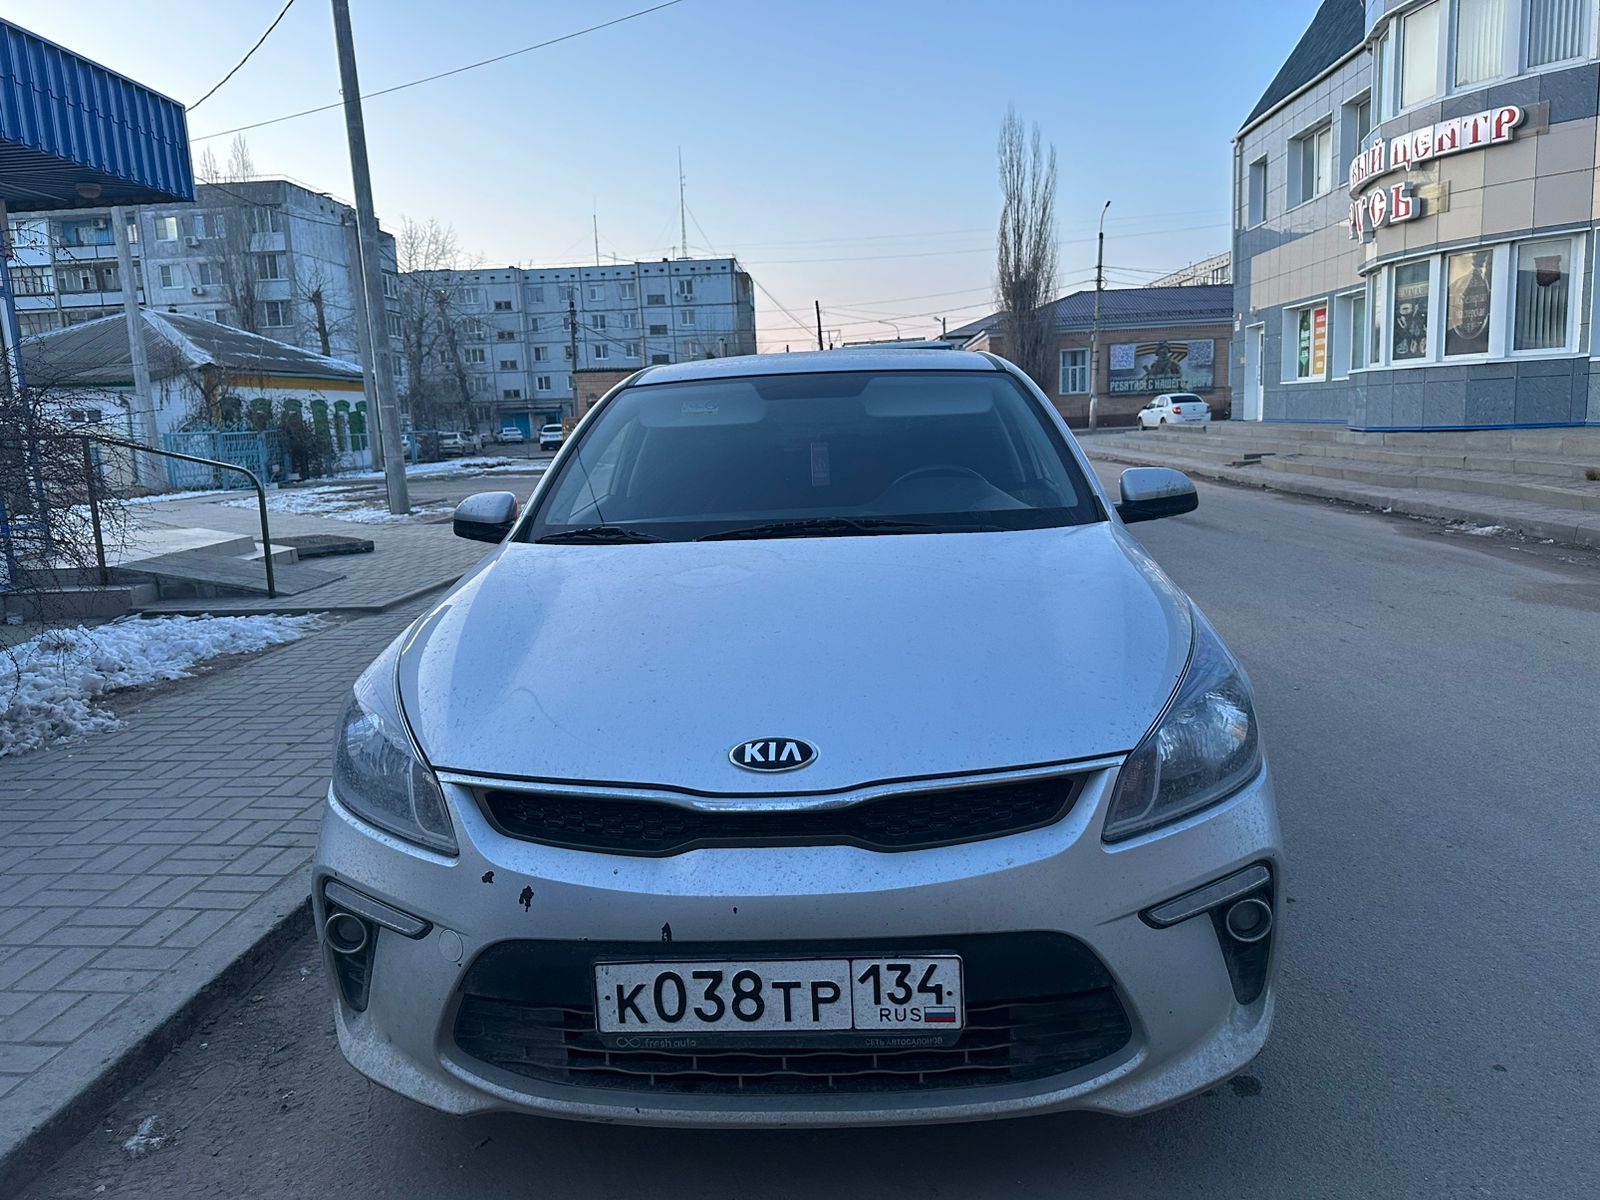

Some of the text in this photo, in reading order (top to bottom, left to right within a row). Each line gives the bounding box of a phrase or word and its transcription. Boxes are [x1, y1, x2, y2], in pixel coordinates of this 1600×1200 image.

[1351, 140, 1383, 185] ВЫЙ
[744, 741, 802, 763] KIA
[857, 963, 945, 1006] 134
[879, 1007, 922, 1022] RUS
[645, 1038, 696, 1048] fresh auto
